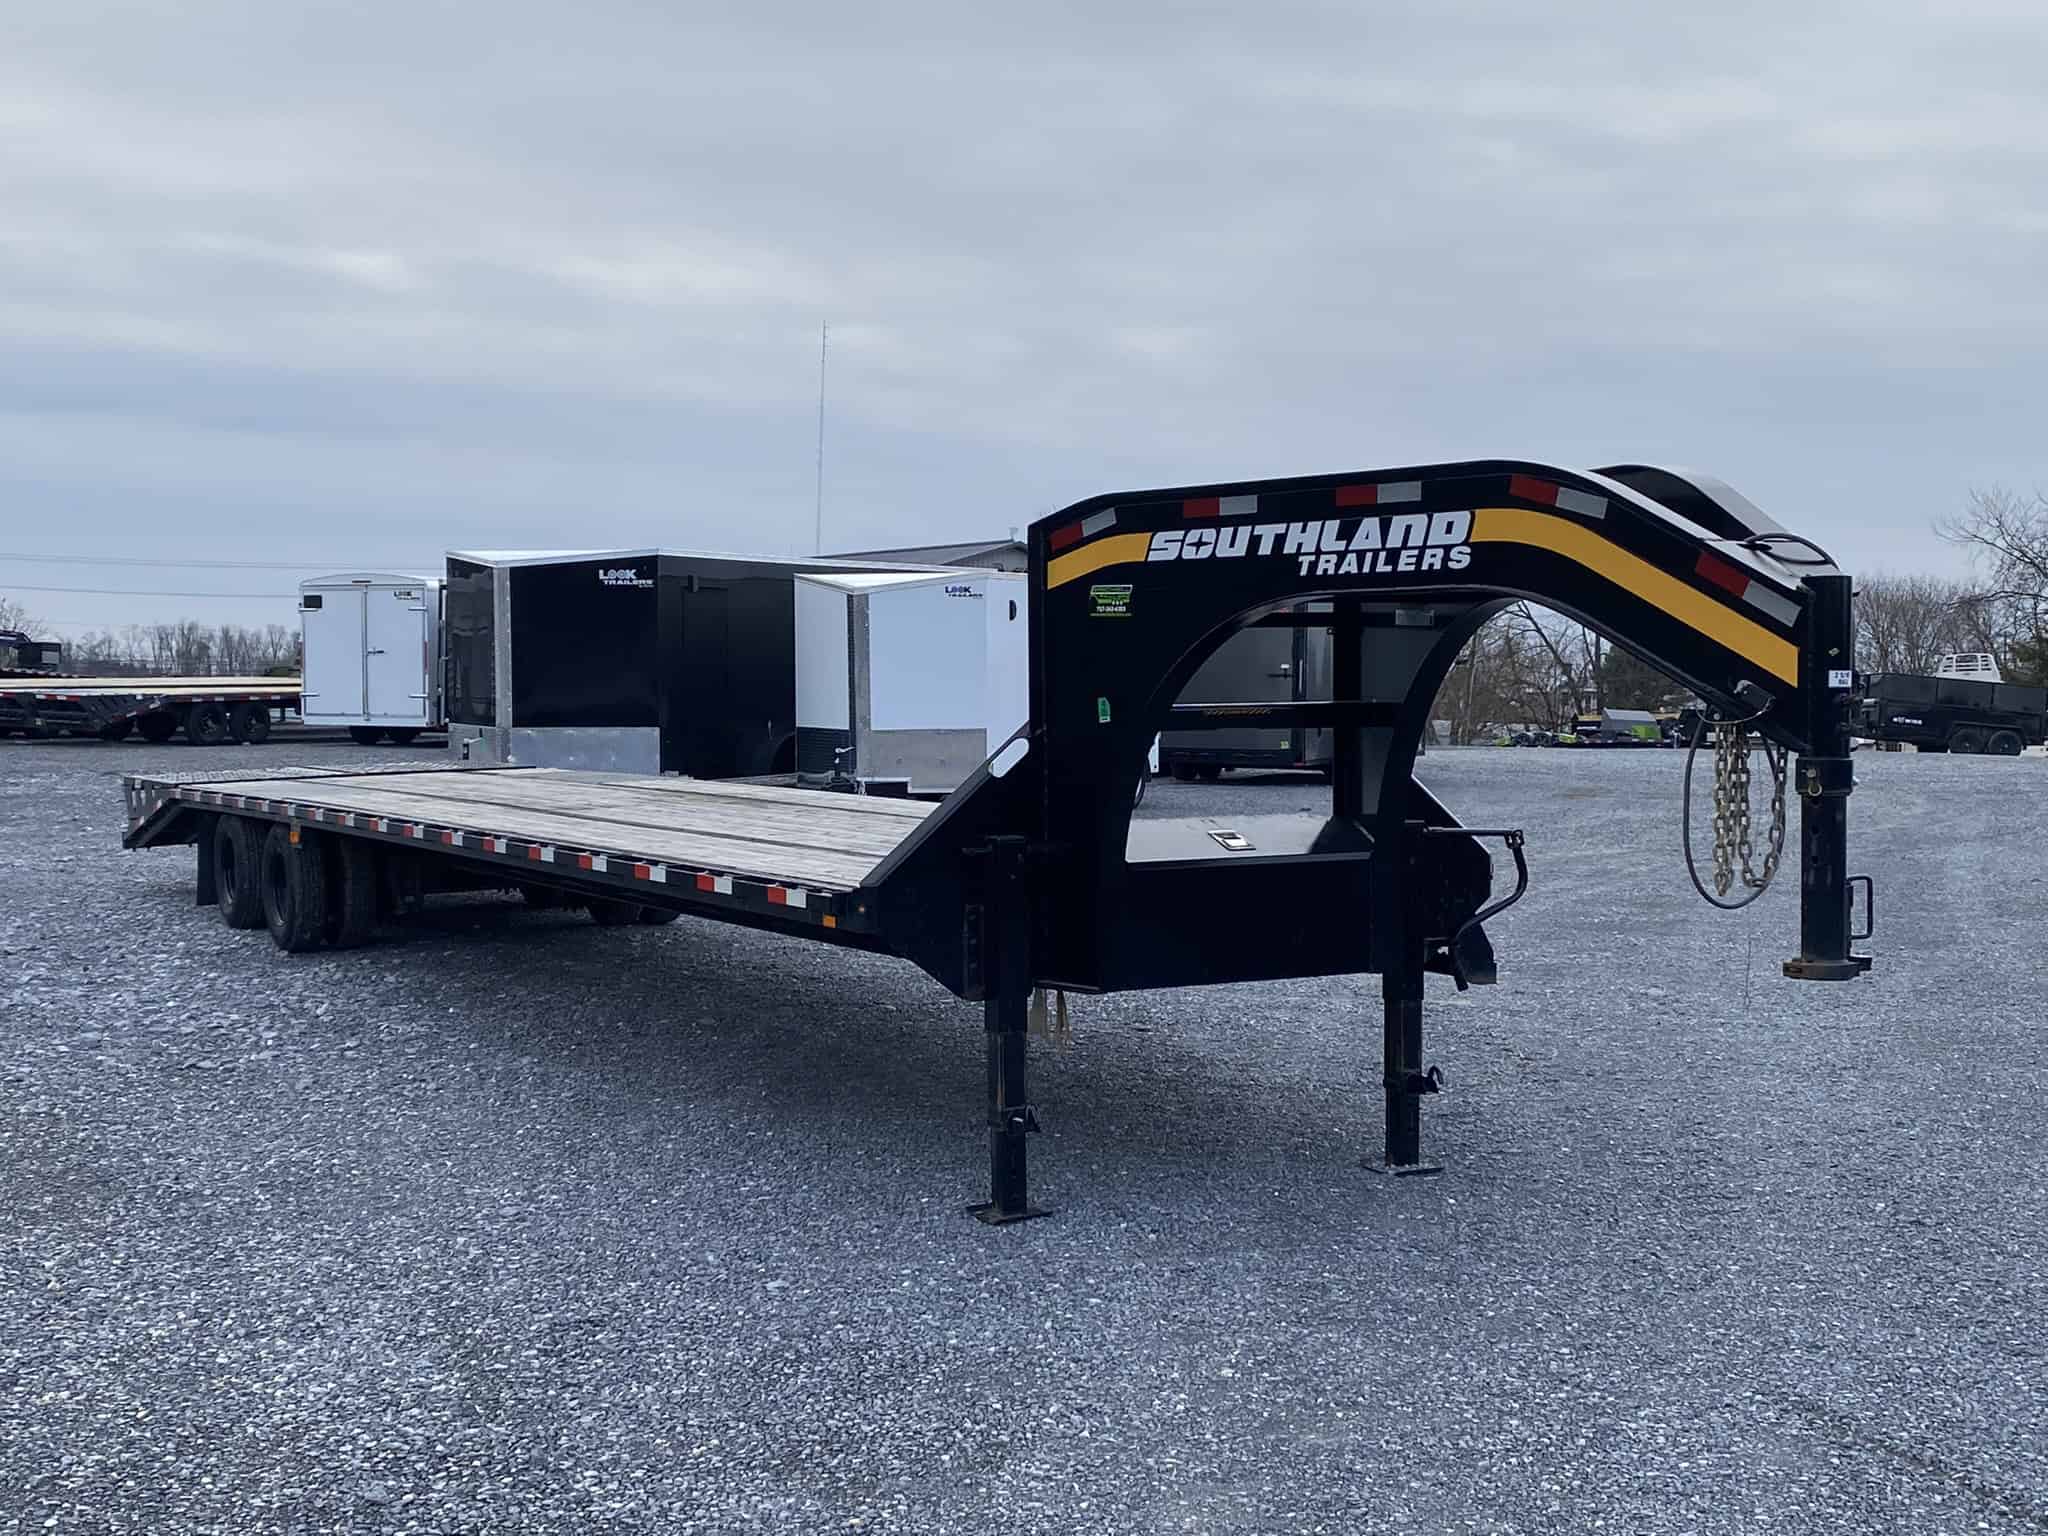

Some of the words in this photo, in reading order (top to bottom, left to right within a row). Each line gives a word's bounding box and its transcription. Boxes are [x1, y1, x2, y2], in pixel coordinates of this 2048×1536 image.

[1147, 510, 1472, 562] SOUTHLAND
[599, 569, 637, 579] LOOK
[1298, 545, 1472, 577] TRAILERS
